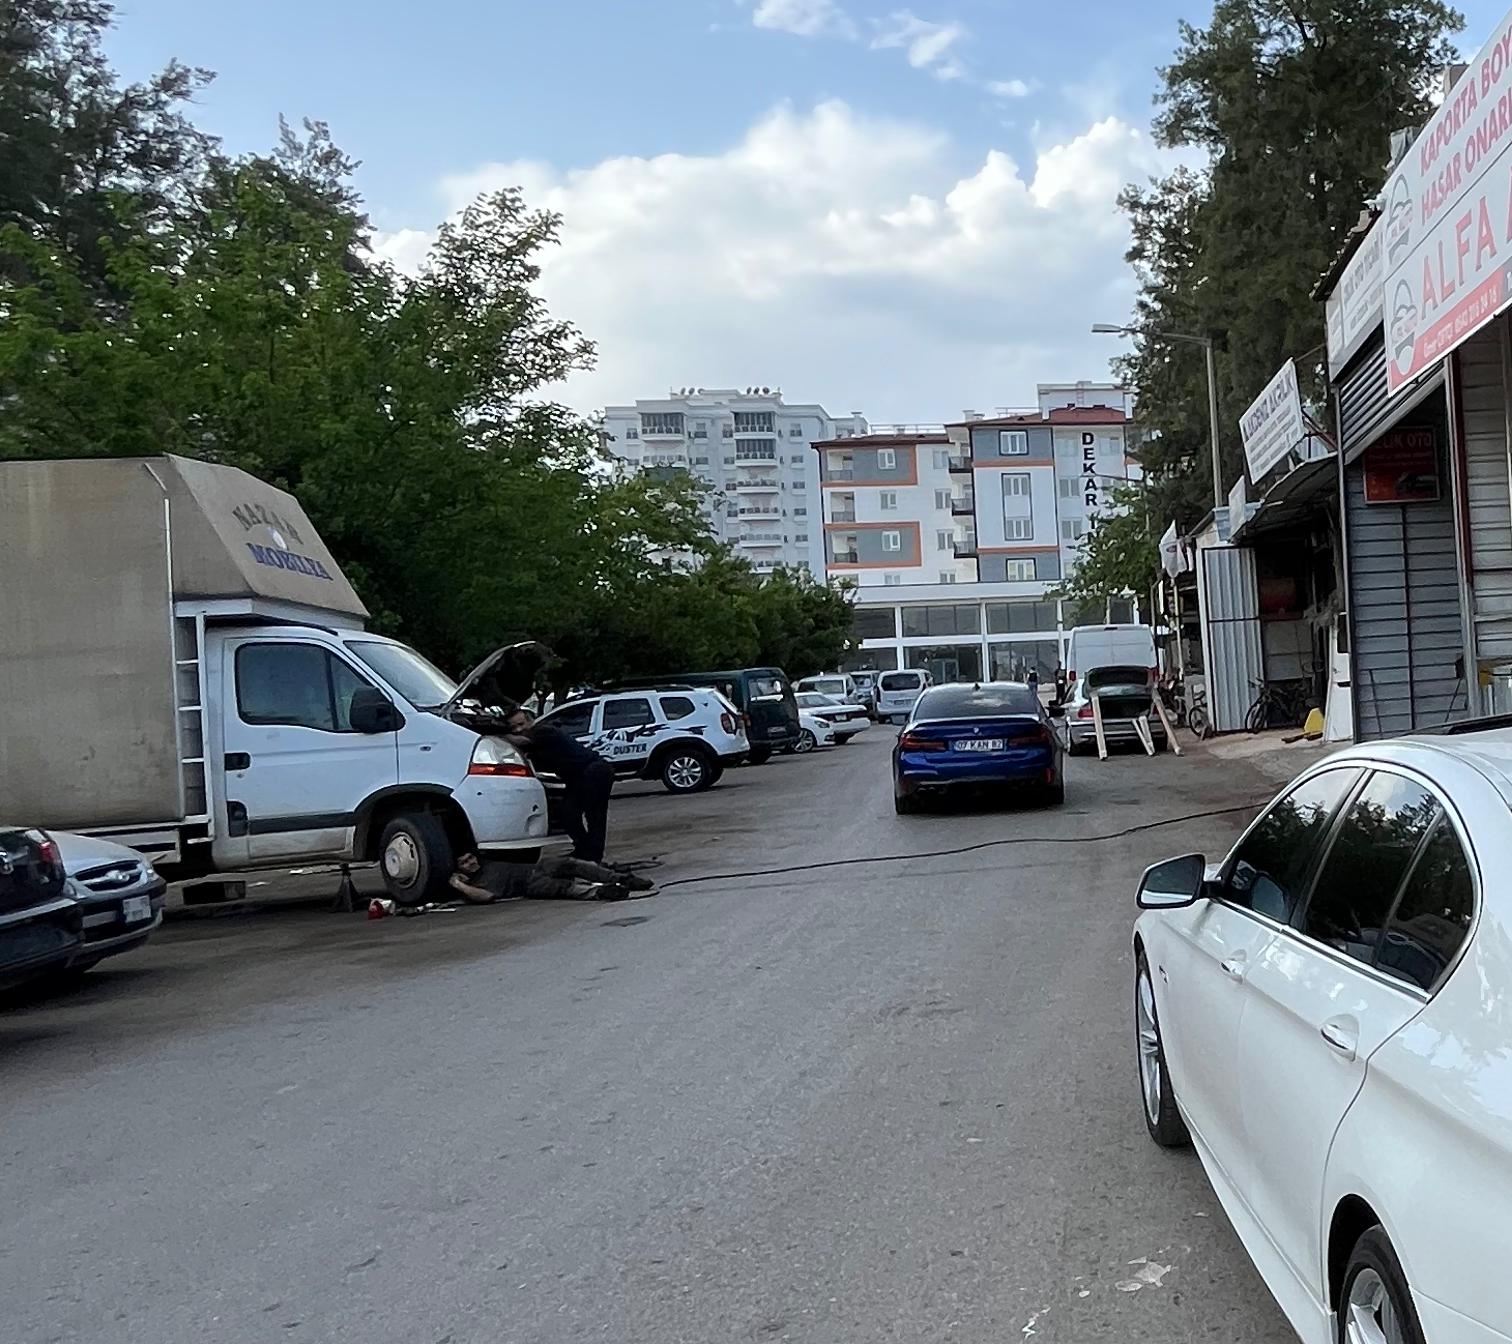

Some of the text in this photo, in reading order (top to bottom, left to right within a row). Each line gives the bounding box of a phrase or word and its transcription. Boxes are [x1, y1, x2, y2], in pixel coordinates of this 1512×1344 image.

[1421, 77, 1477, 176] KAPORTA
[1422, 152, 1462, 225] HASAR
[1421, 196, 1498, 320] ALFA
[1081, 431, 1098, 507] DEKAR
[613, 742, 648, 755] DUSTER
